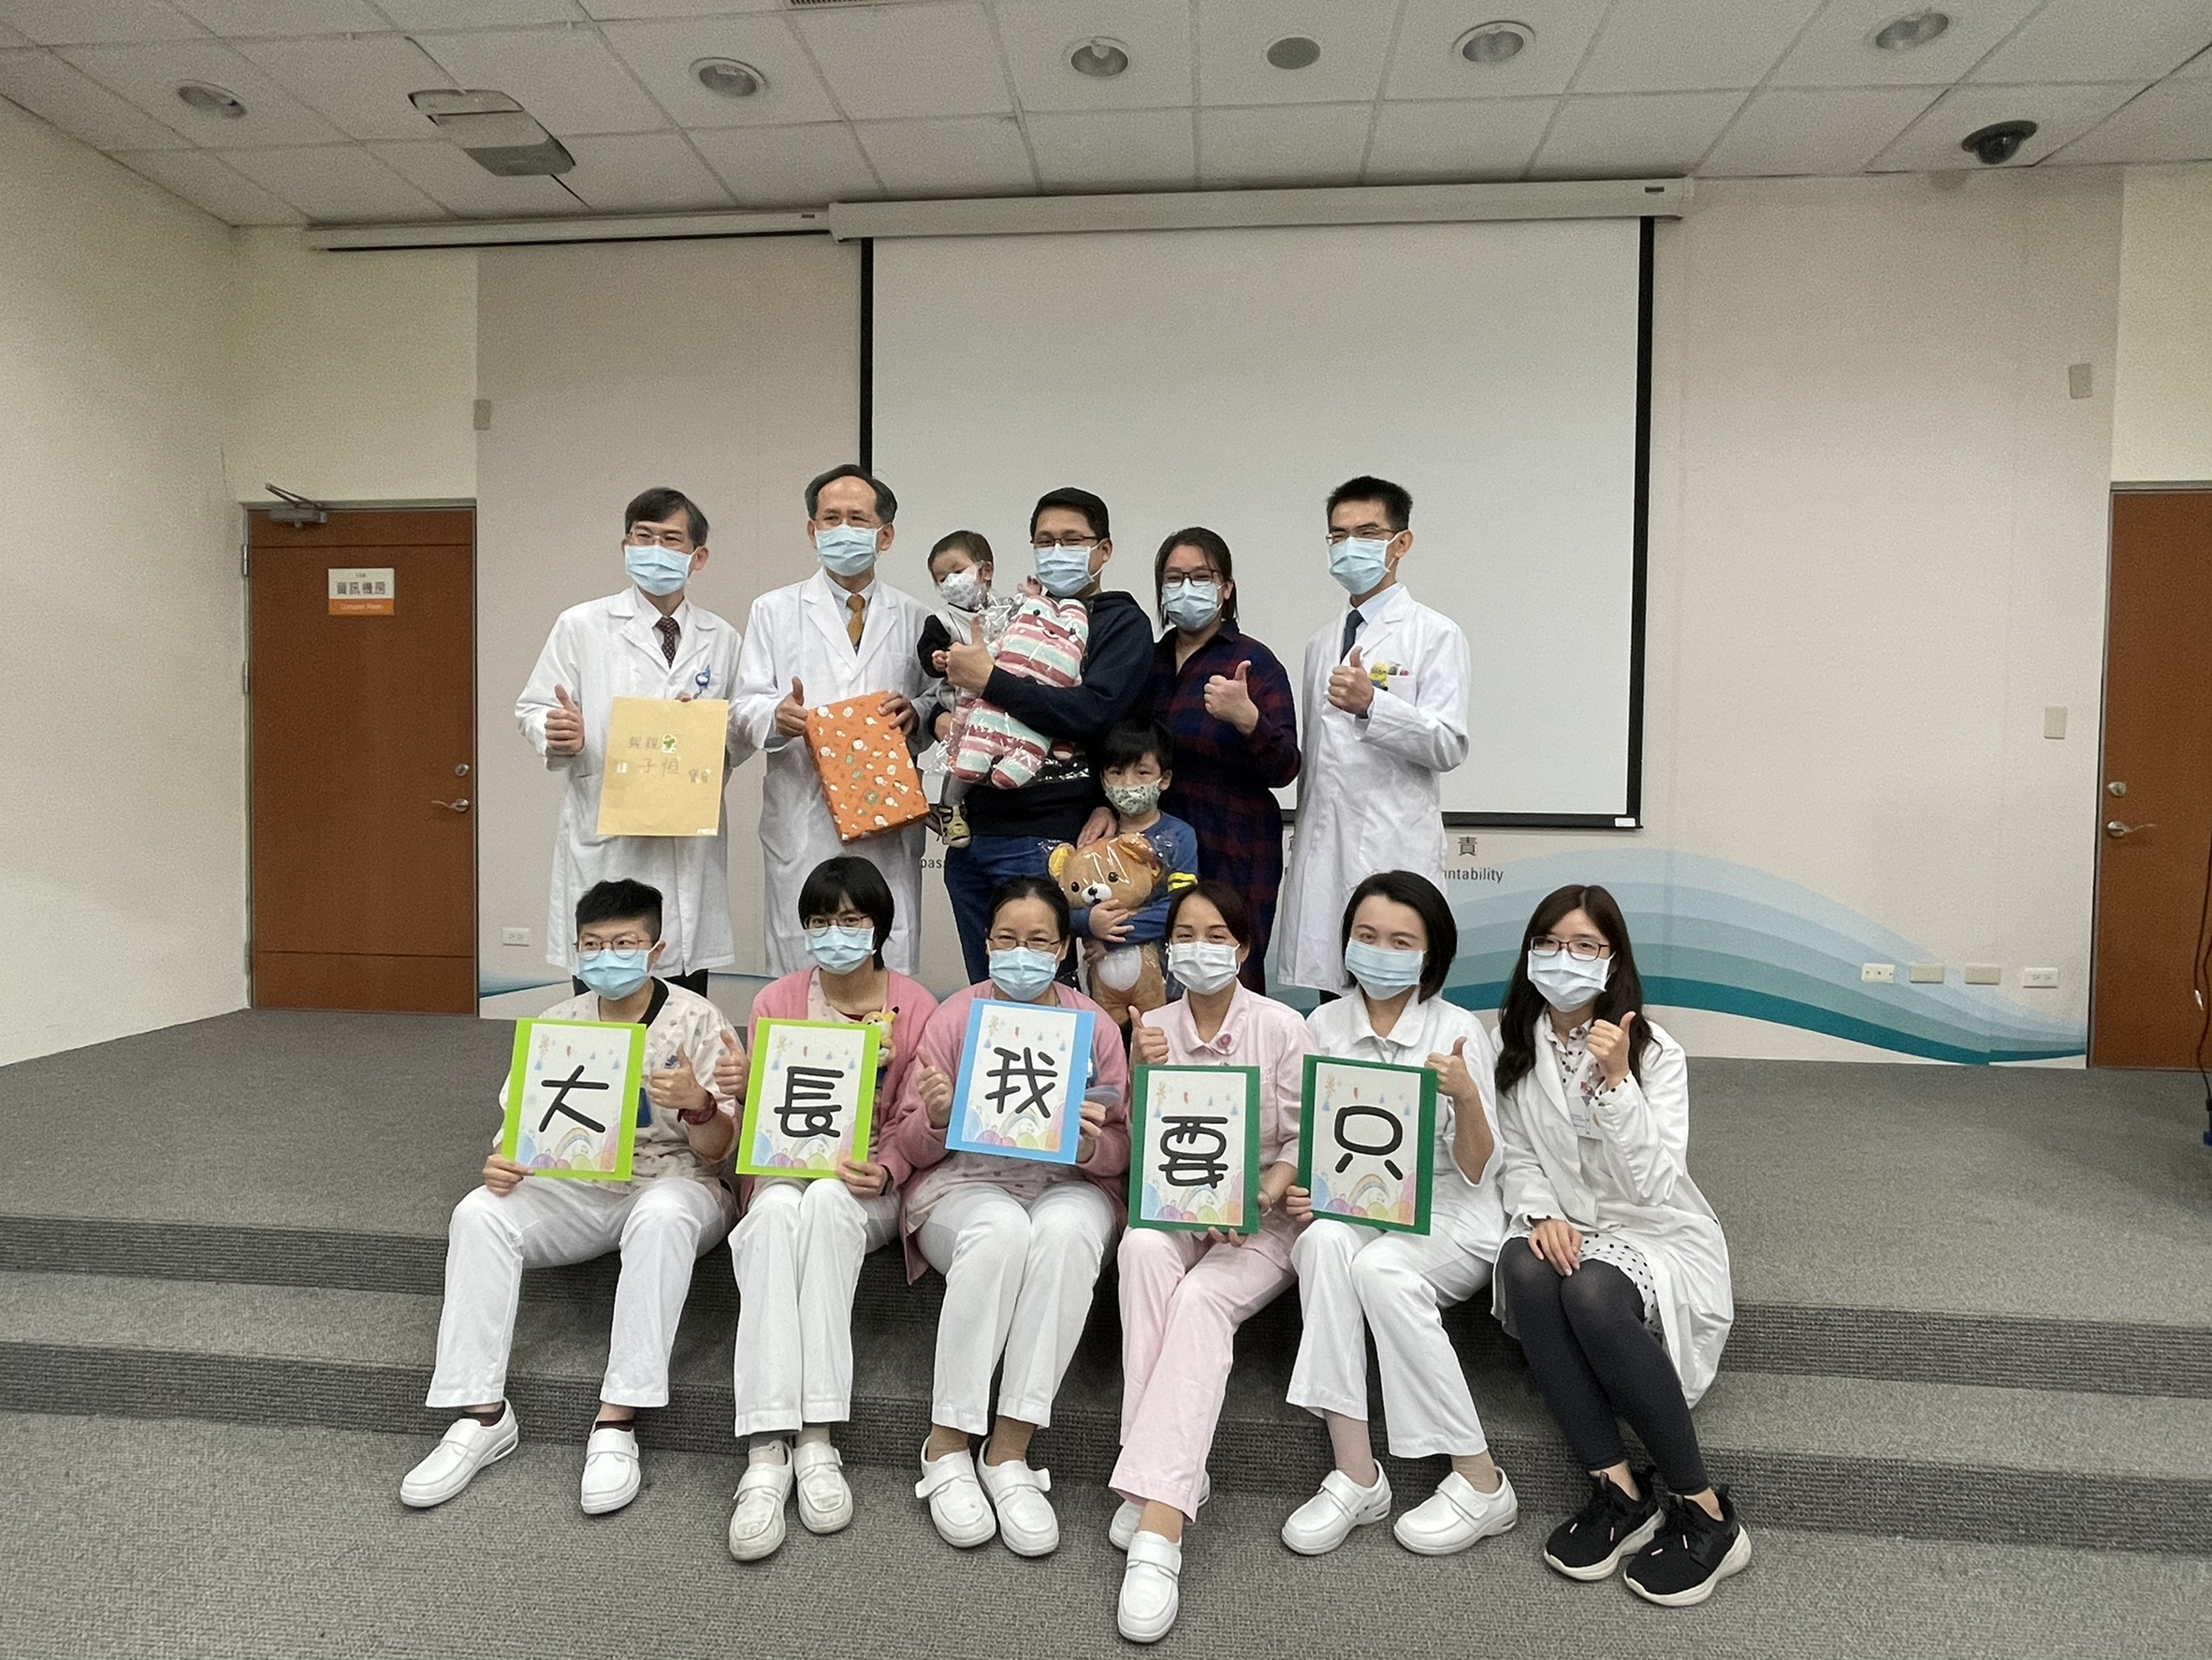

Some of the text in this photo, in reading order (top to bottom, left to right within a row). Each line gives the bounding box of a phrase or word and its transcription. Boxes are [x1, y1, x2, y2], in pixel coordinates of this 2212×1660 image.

[1457, 836, 1478, 856] 責
[538, 1064, 610, 1133] 大
[773, 1065, 845, 1138] 長
[984, 1046, 1058, 1119] 我
[1333, 1105, 1404, 1181] 只
